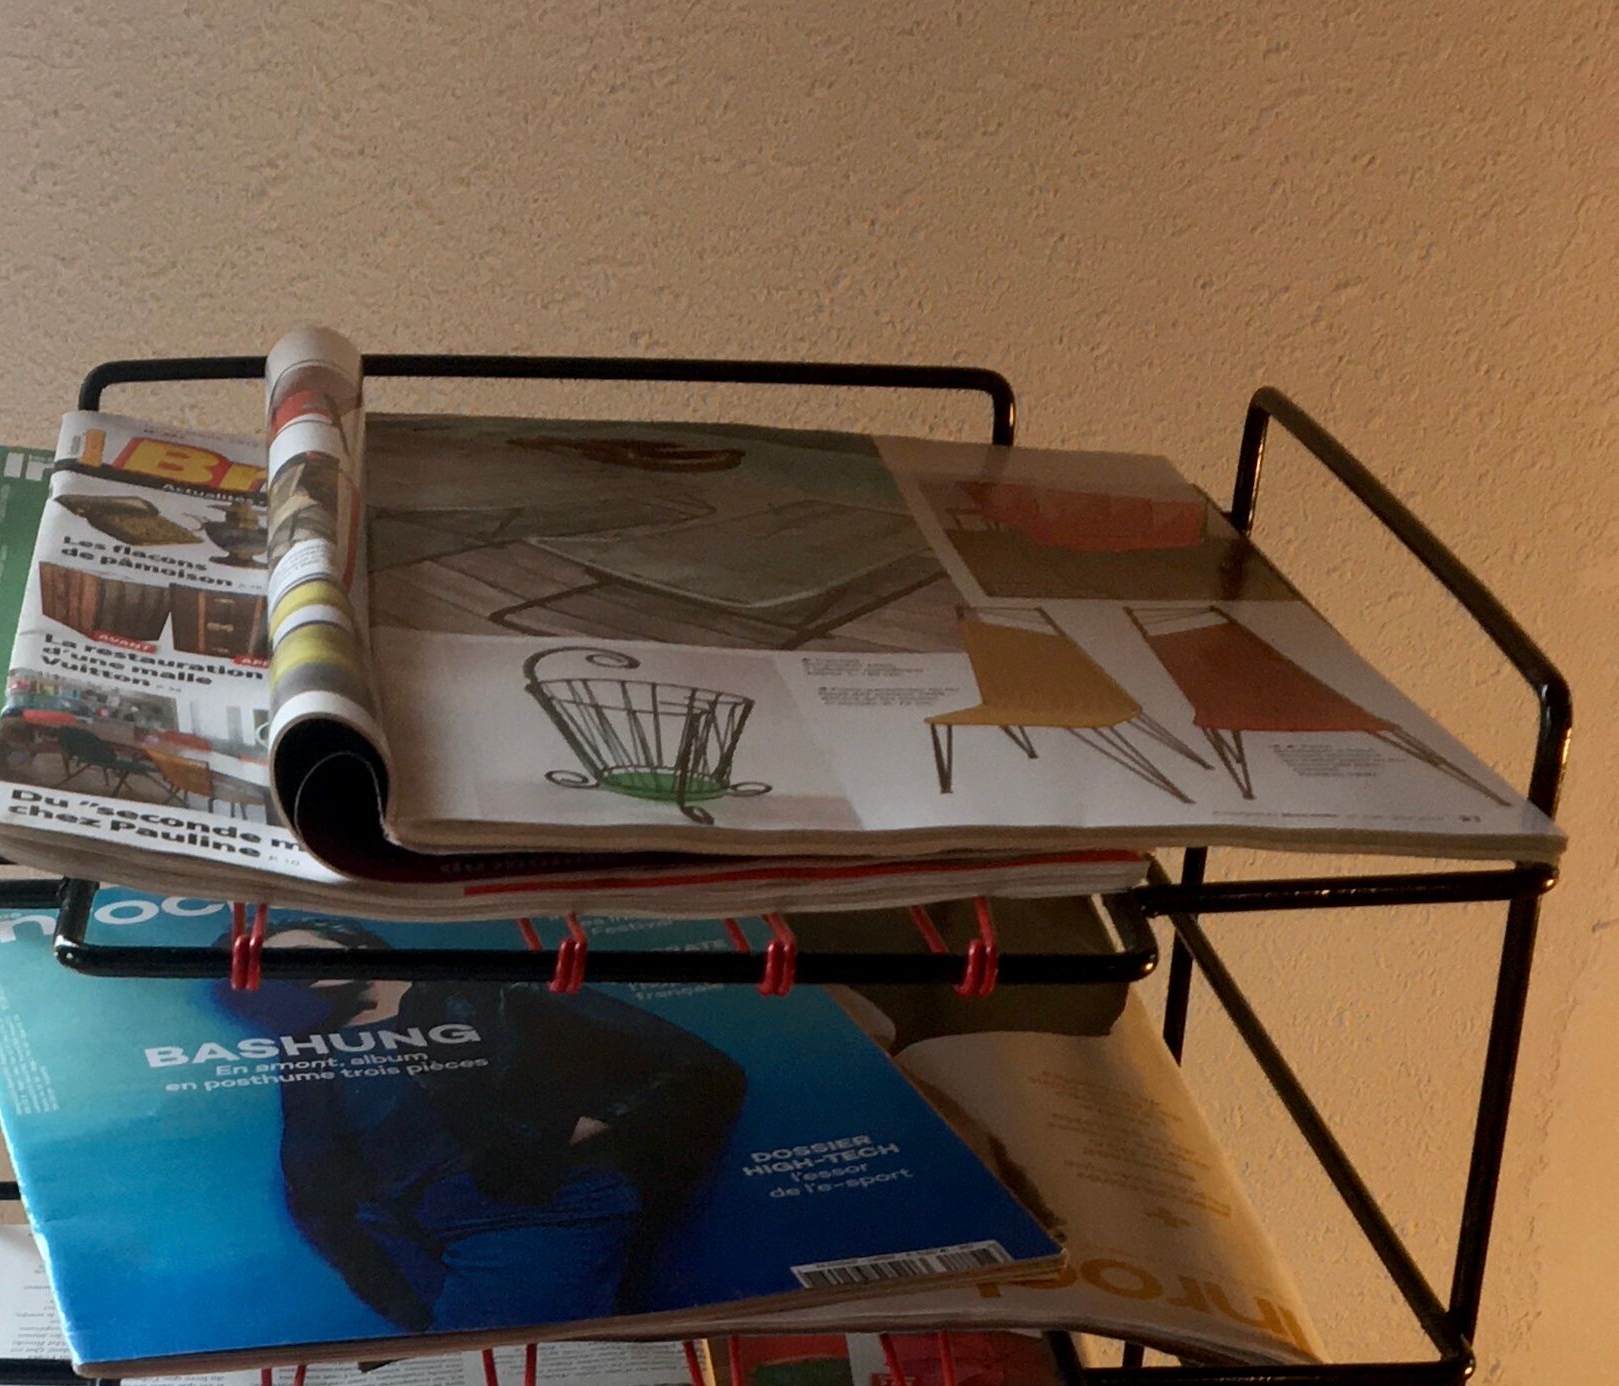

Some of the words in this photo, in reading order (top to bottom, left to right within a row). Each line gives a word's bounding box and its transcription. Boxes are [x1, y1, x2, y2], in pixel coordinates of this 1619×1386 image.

[61, 546, 97, 562] de
[99, 551, 233, 586] pâmoison
[63, 535, 106, 550] Les
[112, 536, 208, 571] flacons
[44, 633, 77, 650] La
[84, 642, 264, 680] restauration
[97, 633, 155, 652] AVANT
[41, 655, 151, 687] Vuitton
[42, 645, 118, 673] d'une
[131, 658, 213, 686] malle
[11, 788, 69, 808] Du
[8, 803, 102, 829] chez
[109, 819, 261, 859] Pauline
[144, 1023, 482, 1068] BASHUNG
[165, 1081, 199, 1093] en
[204, 1071, 336, 1092] posthume
[340, 1064, 401, 1079] trois
[407, 1056, 489, 1077] pièces
[216, 1064, 253, 1077] En
[255, 1058, 346, 1074] amont,
[350, 1051, 430, 1067] album
[742, 1143, 901, 1177] HIGH-TECH
[750, 1135, 873, 1163] DOSSIER
[769, 1186, 801, 1199] de
